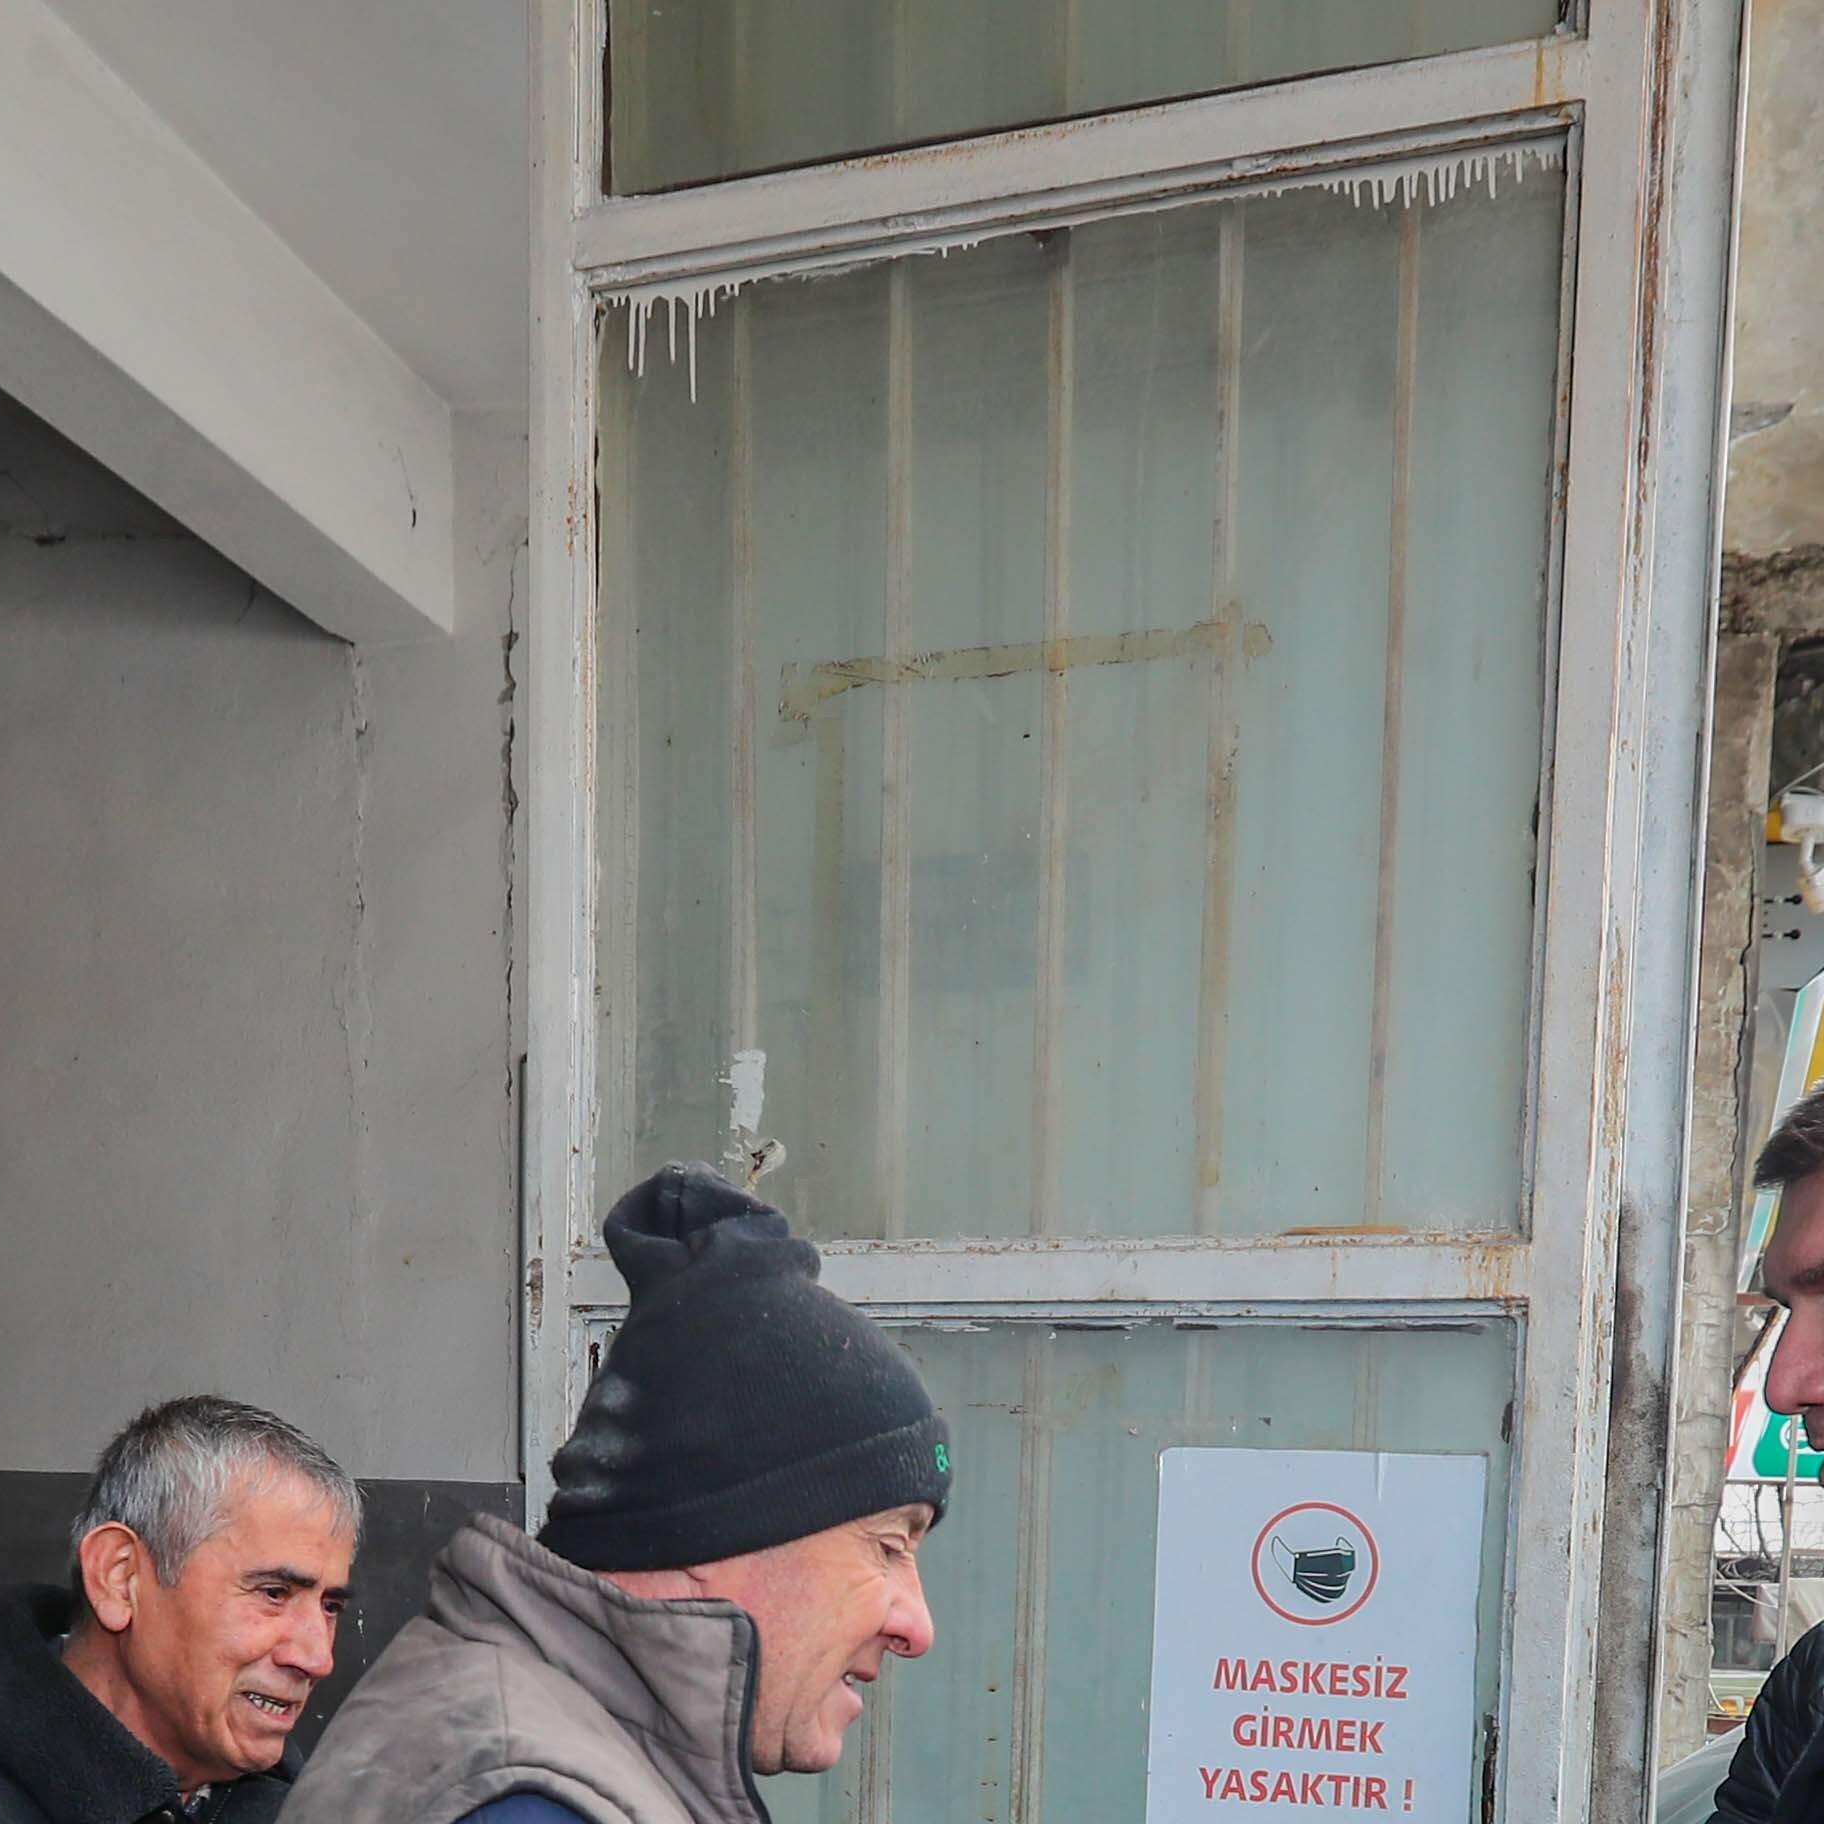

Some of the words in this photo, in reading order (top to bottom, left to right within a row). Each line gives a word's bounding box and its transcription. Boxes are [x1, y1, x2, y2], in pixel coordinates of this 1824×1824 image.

[1213, 1656, 1409, 1699] MASKESİZ
[1233, 1705, 1385, 1754] GİRMEK
[1198, 1766, 1388, 1810] YASAKTIR
